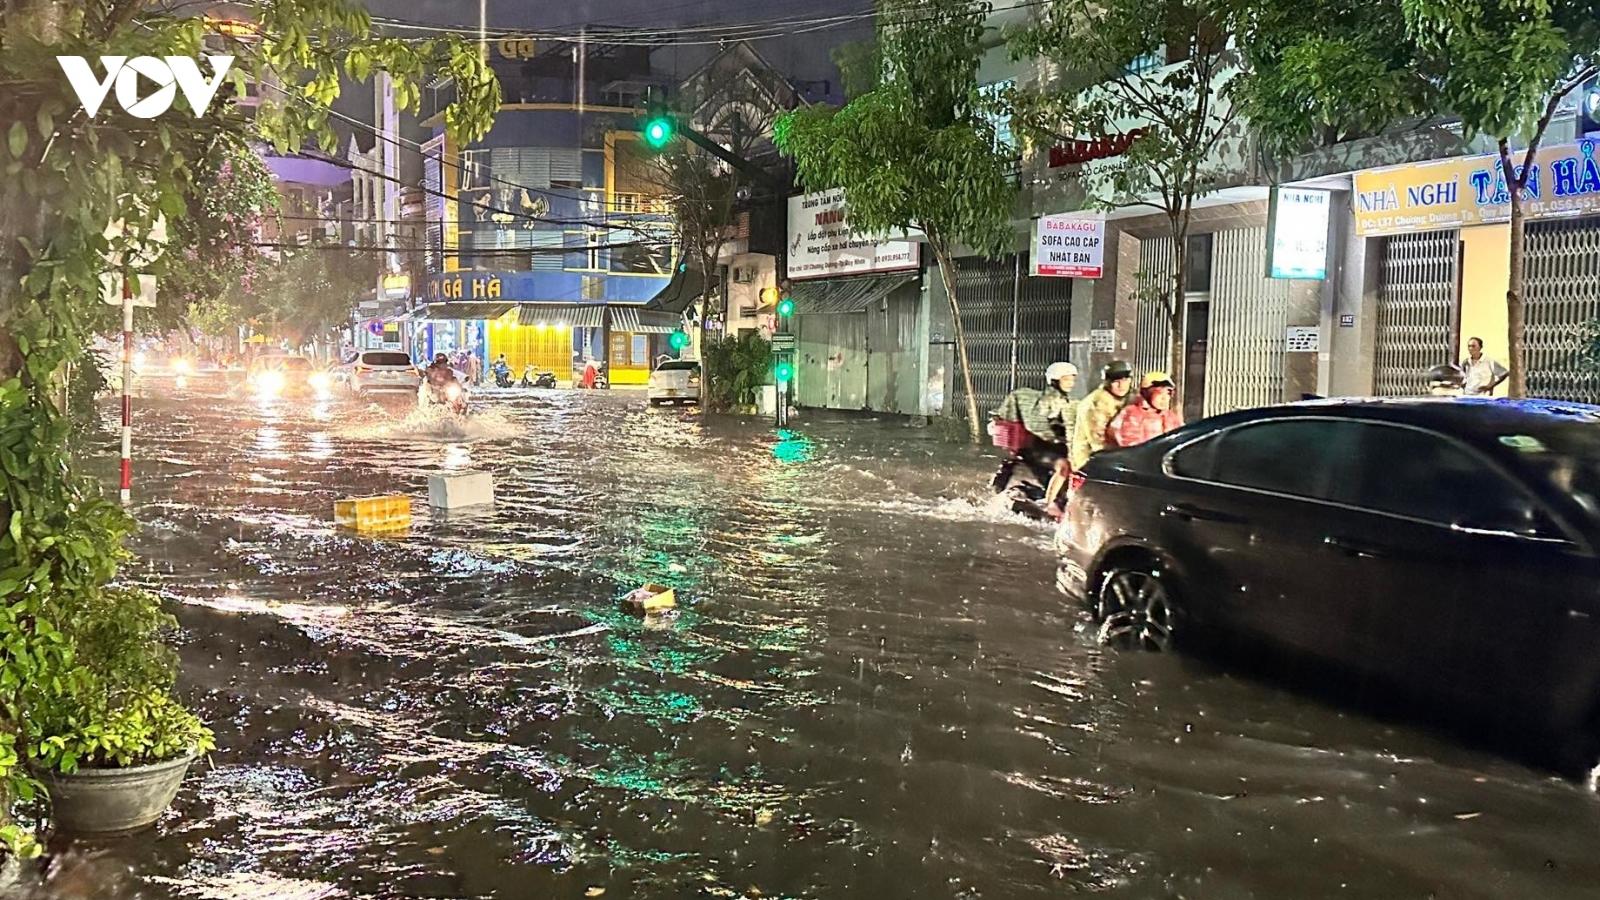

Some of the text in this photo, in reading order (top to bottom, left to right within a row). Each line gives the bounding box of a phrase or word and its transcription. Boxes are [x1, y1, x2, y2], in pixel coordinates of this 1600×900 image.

[1360, 183, 1398, 213] NHÀ
[1407, 174, 1459, 207] NGHỈ
[1046, 221, 1096, 232] BABAKAGU
[1042, 235, 1062, 246] SOFA
[1064, 236, 1081, 247] CAO
[442, 274, 463, 299] GÀ
[472, 274, 501, 299] HÀ
